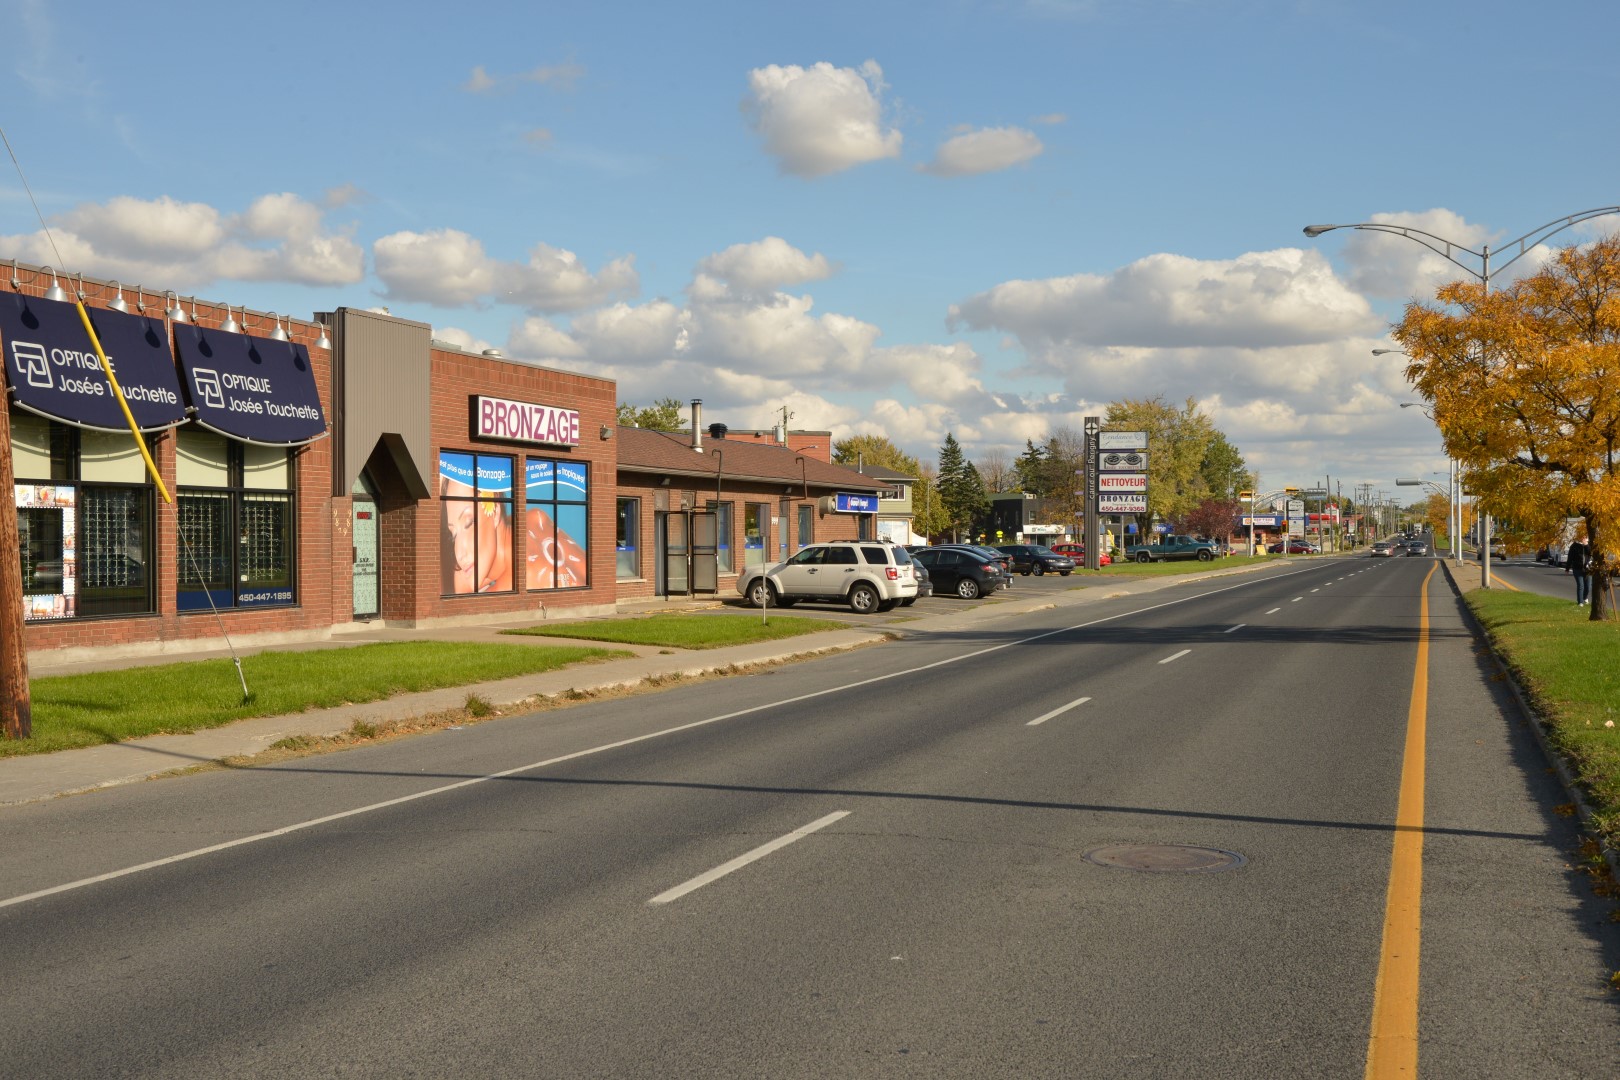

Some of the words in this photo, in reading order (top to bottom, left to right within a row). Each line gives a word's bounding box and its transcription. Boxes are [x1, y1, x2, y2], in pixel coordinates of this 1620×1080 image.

[59, 375, 104, 396] Josée
[105, 380, 177, 405] Tuchette
[222, 373, 272, 393] OPTIQUE
[228, 396, 263, 414] Josée
[264, 401, 319, 420] Touchette
[481, 399, 579, 444] BRONZAGE
[1101, 478, 1146, 487] NETTOYEUR
